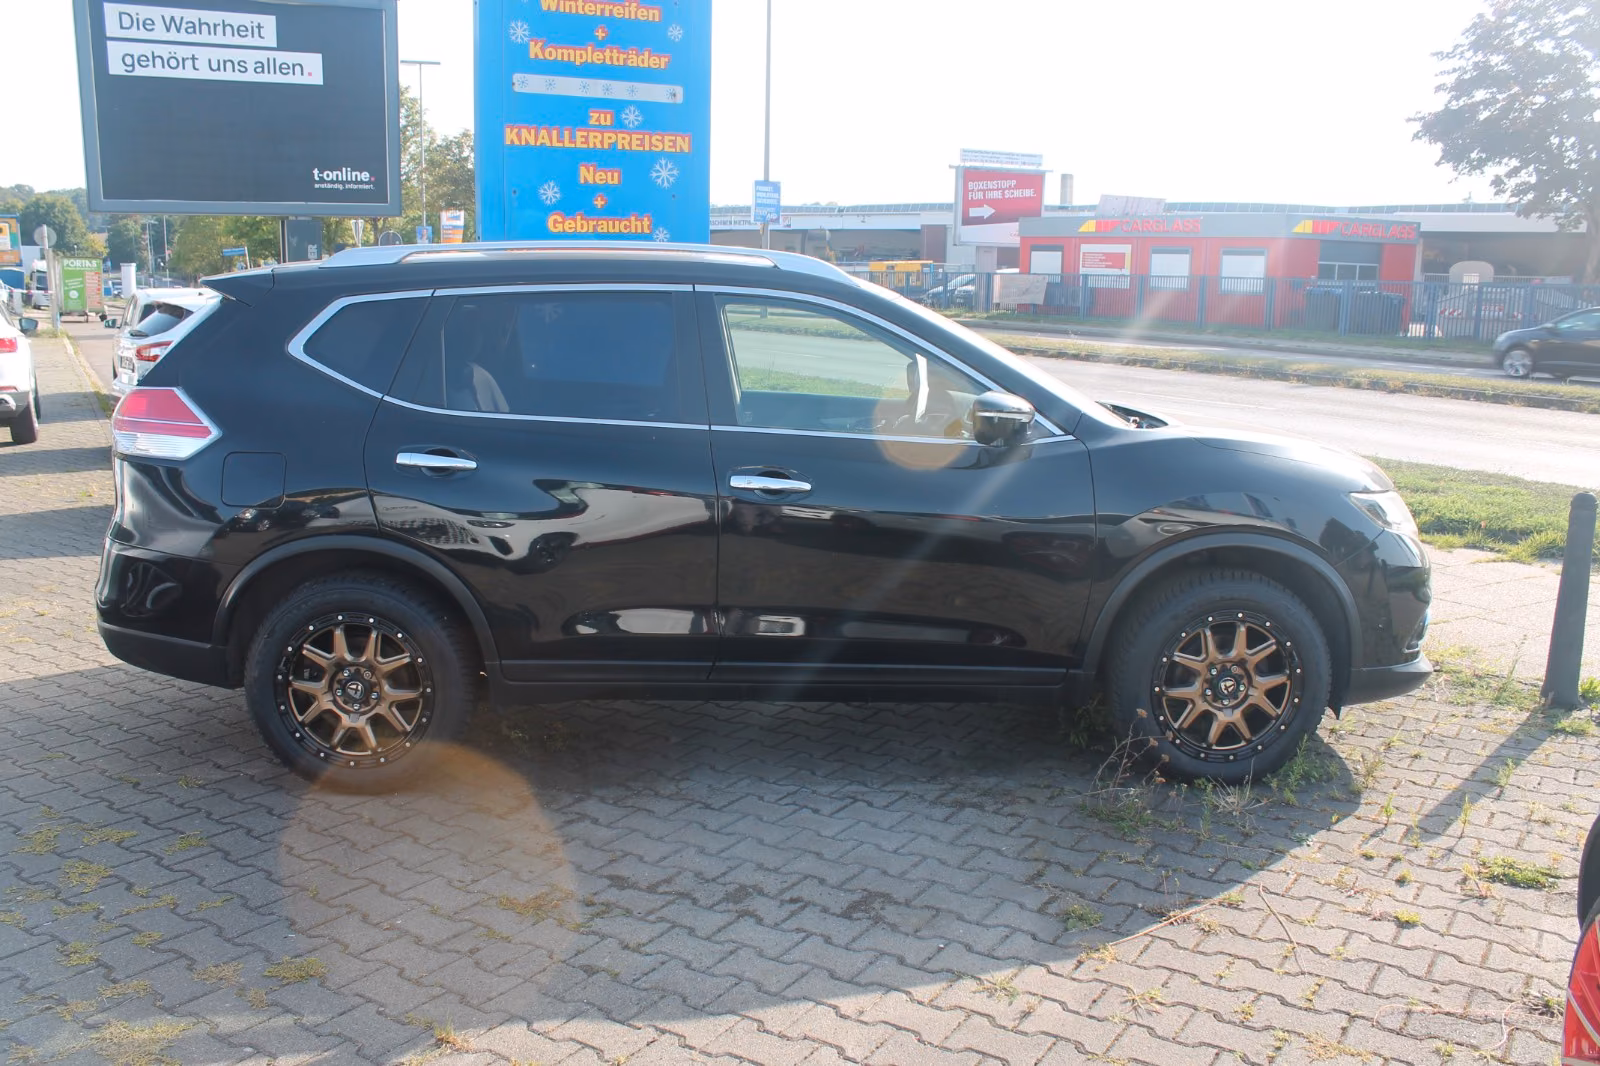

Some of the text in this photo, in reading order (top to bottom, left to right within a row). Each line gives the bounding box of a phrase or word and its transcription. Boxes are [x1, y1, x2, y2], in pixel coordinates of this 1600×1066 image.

[540, 0, 661, 22] Winterreifen
[118, 11, 265, 40] Die Wahrheit
[121, 50, 313, 77] gehört uns allen.
[528, 38, 671, 70] Kompletträder
[588, 110, 614, 126] zu
[504, 124, 692, 153] KNALLERPREISEN
[578, 163, 621, 185] Neu
[968, 180, 1016, 190] BOXENSTOPP
[968, 188, 1036, 200] FÜR IHRE SCHEIBE.
[547, 211, 652, 234] Gebraucht
[1121, 219, 1200, 232] CARGLASS
[1341, 221, 1416, 239] CARGLASS
